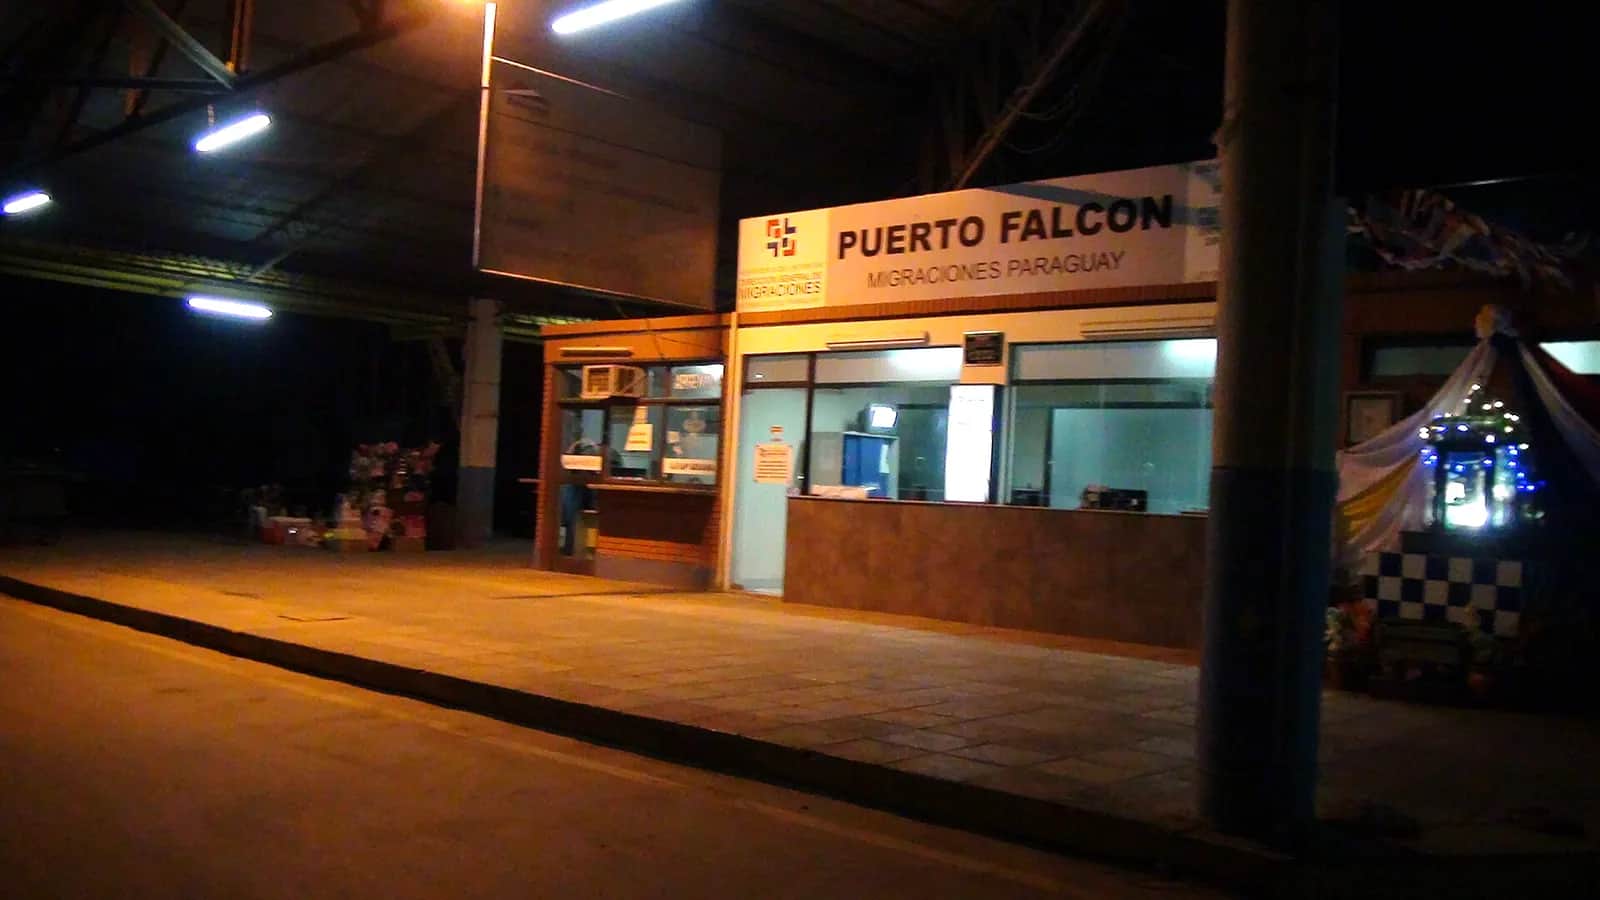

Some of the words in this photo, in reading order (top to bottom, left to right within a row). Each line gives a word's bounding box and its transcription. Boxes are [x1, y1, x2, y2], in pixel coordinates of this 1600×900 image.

[838, 216, 984, 259] PUERTO
[1000, 195, 1173, 243] FALCON
[867, 261, 1001, 288] MIGRACIONES
[1007, 251, 1125, 277] PARAGUAY
[739, 281, 821, 299] MIGRACIONES
